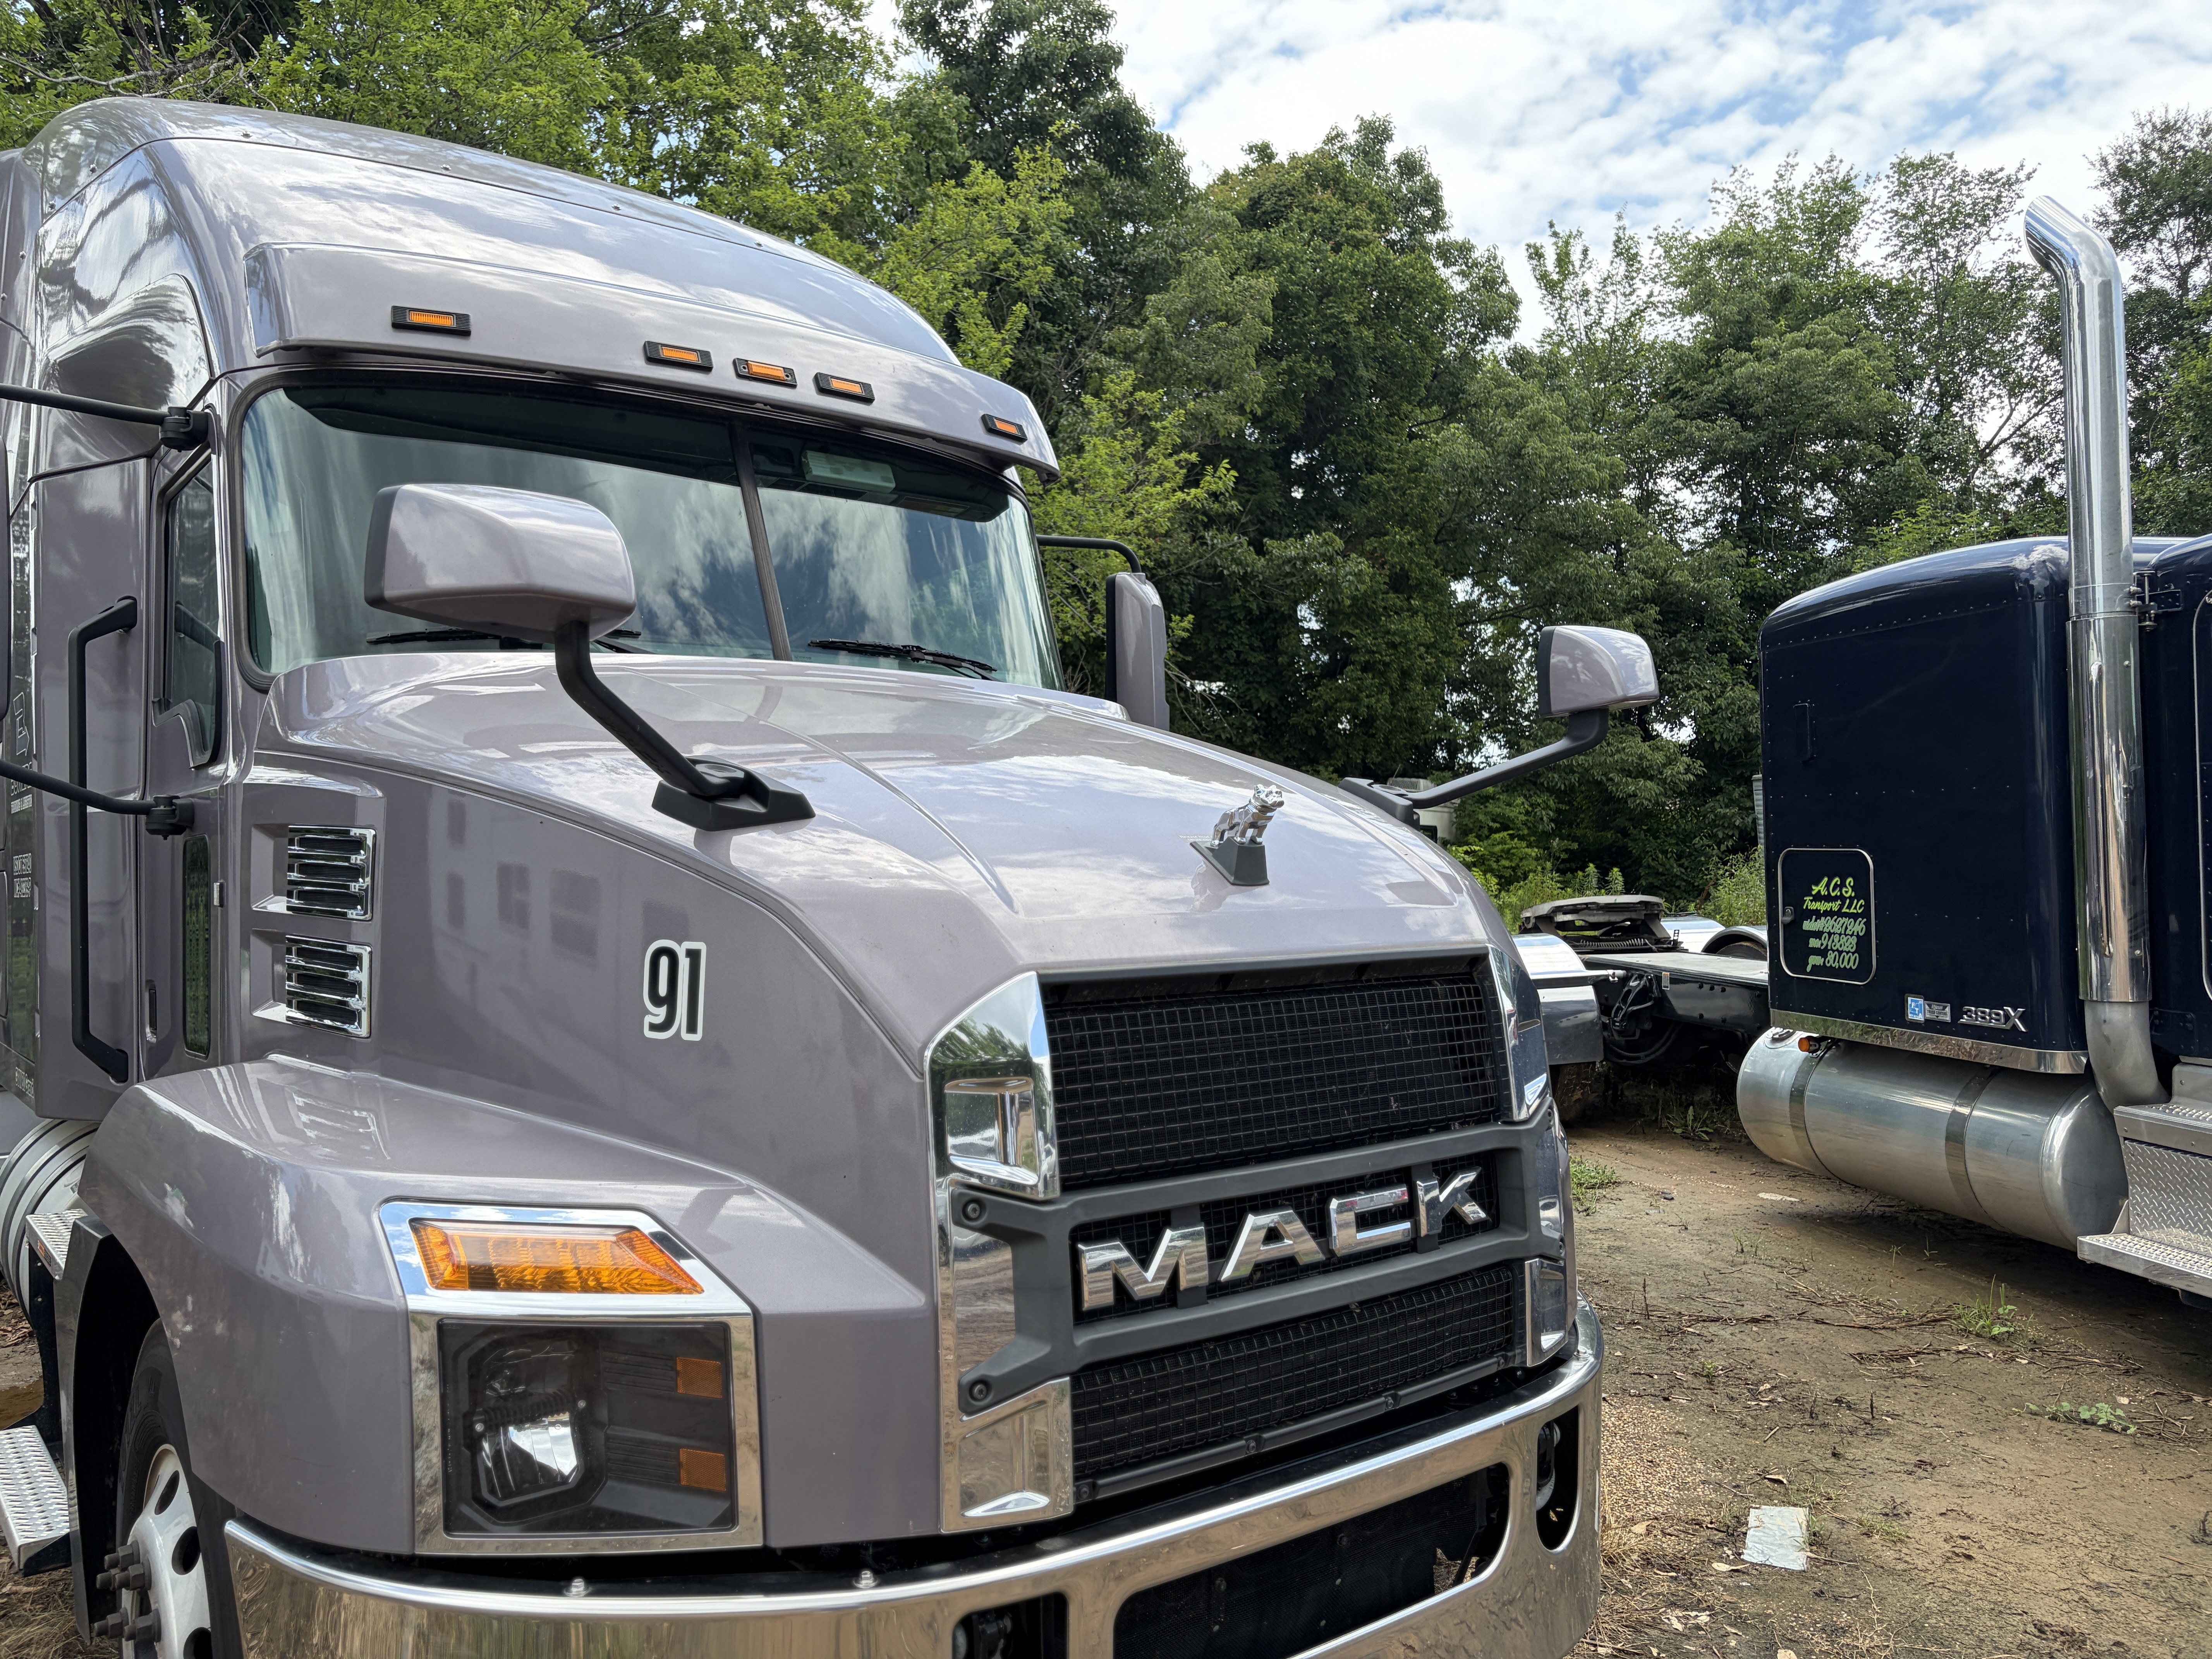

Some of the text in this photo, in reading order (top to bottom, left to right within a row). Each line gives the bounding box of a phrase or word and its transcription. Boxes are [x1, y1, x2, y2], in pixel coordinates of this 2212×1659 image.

[1812, 876, 1855, 897] A.C.S.
[1803, 896, 1865, 914] Transport LLC
[1825, 951, 1859, 970] 80,000
[643, 939, 706, 1041] 91
[1962, 1006, 2028, 1032] 389X
[1078, 1166, 1489, 1310] MACK
